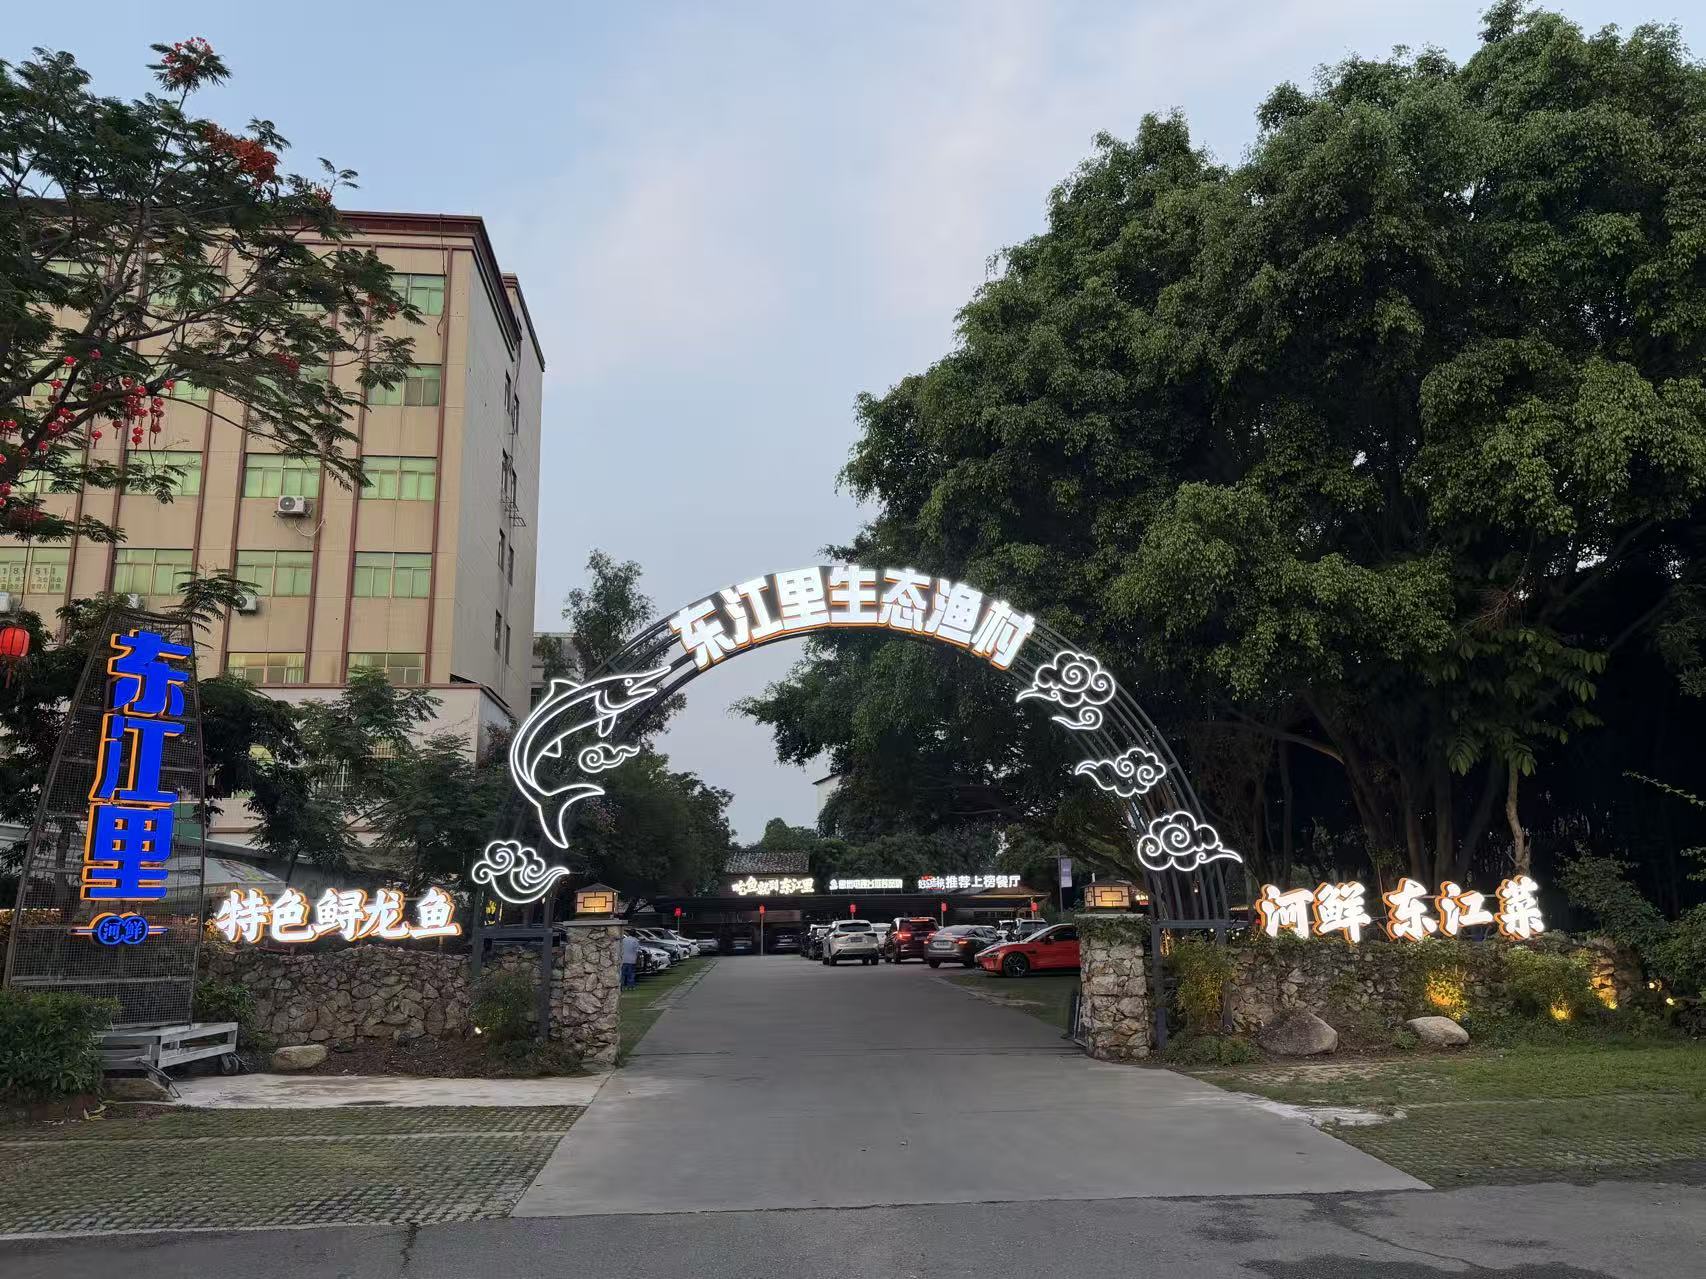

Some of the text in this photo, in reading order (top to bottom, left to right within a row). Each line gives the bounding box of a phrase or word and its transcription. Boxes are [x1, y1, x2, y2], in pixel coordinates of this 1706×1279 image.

[668, 564, 1036, 671] 东江里生态渔村
[81, 628, 193, 901] 东江里
[213, 886, 463, 943] 特色鲟龙鱼
[1256, 874, 1546, 944] 河鲜 东江菜
